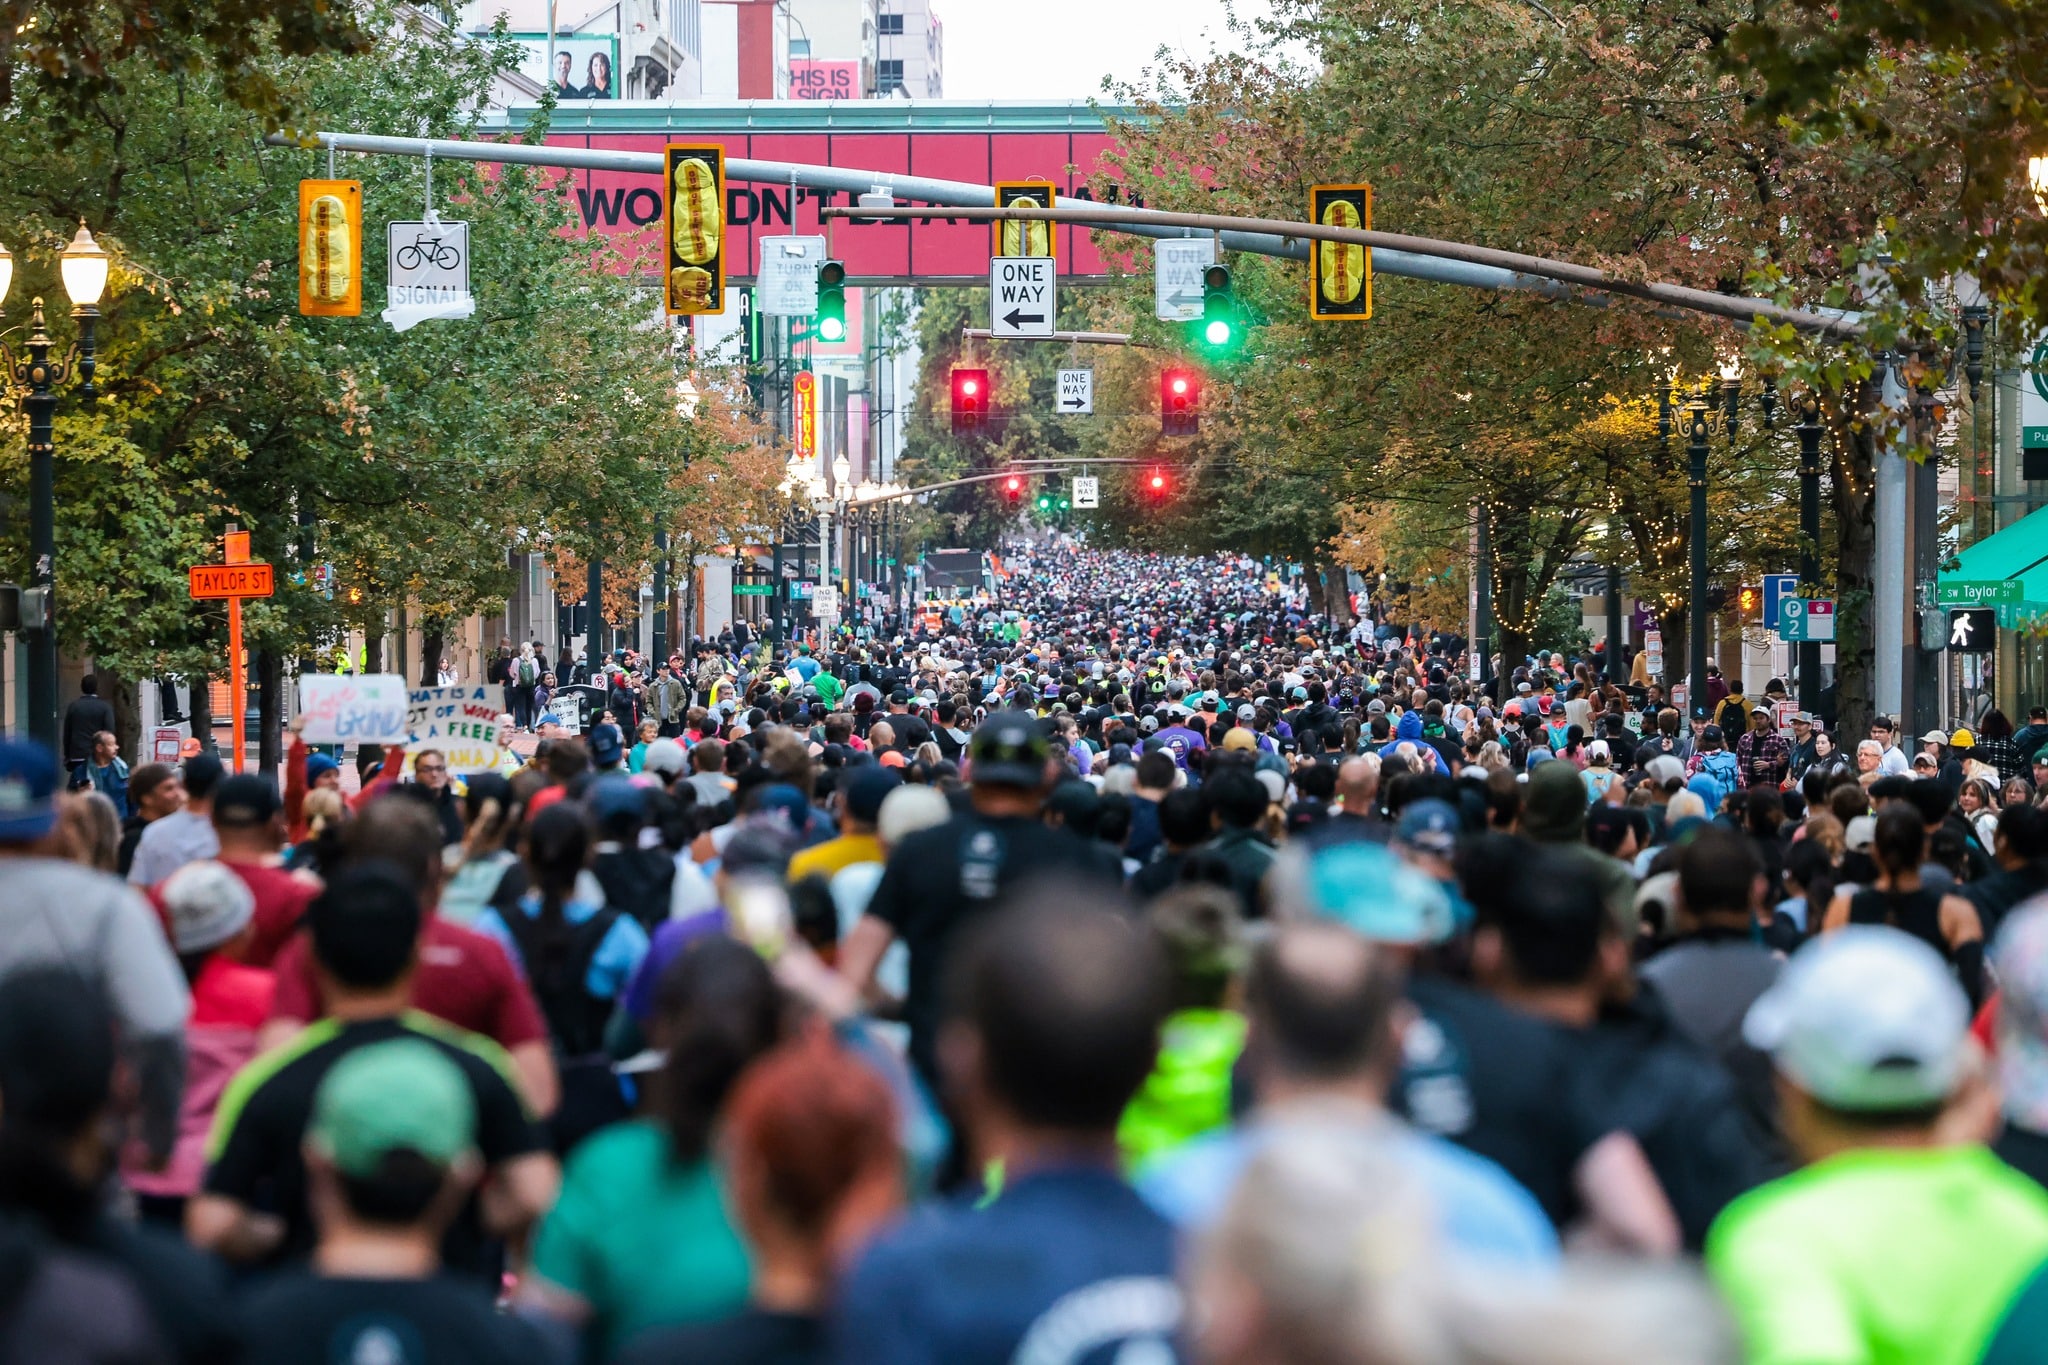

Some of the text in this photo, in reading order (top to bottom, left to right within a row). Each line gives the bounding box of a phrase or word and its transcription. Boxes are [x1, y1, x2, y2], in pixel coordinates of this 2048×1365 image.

[830, 69, 851, 87] IS
[1167, 248, 1208, 264] ONE
[776, 262, 813, 276] TURN
[1003, 264, 1043, 282] ONE
[1001, 285, 1045, 303] WAY
[1063, 373, 1086, 383] ONE
[1062, 384, 1087, 395] WAY
[1077, 480, 1094, 488] ONE
[195, 571, 267, 591] TAYLOR ST
[2002, 581, 2016, 589] 900
[1947, 585, 1998, 602] SW Taylor
[1790, 603, 1799, 615] P
[1788, 620, 1800, 635] 2
[409, 687, 486, 703] HAT IS A
[408, 703, 500, 724] OT OF WORK
[428, 724, 439, 738] A
[447, 721, 495, 743] FREE
